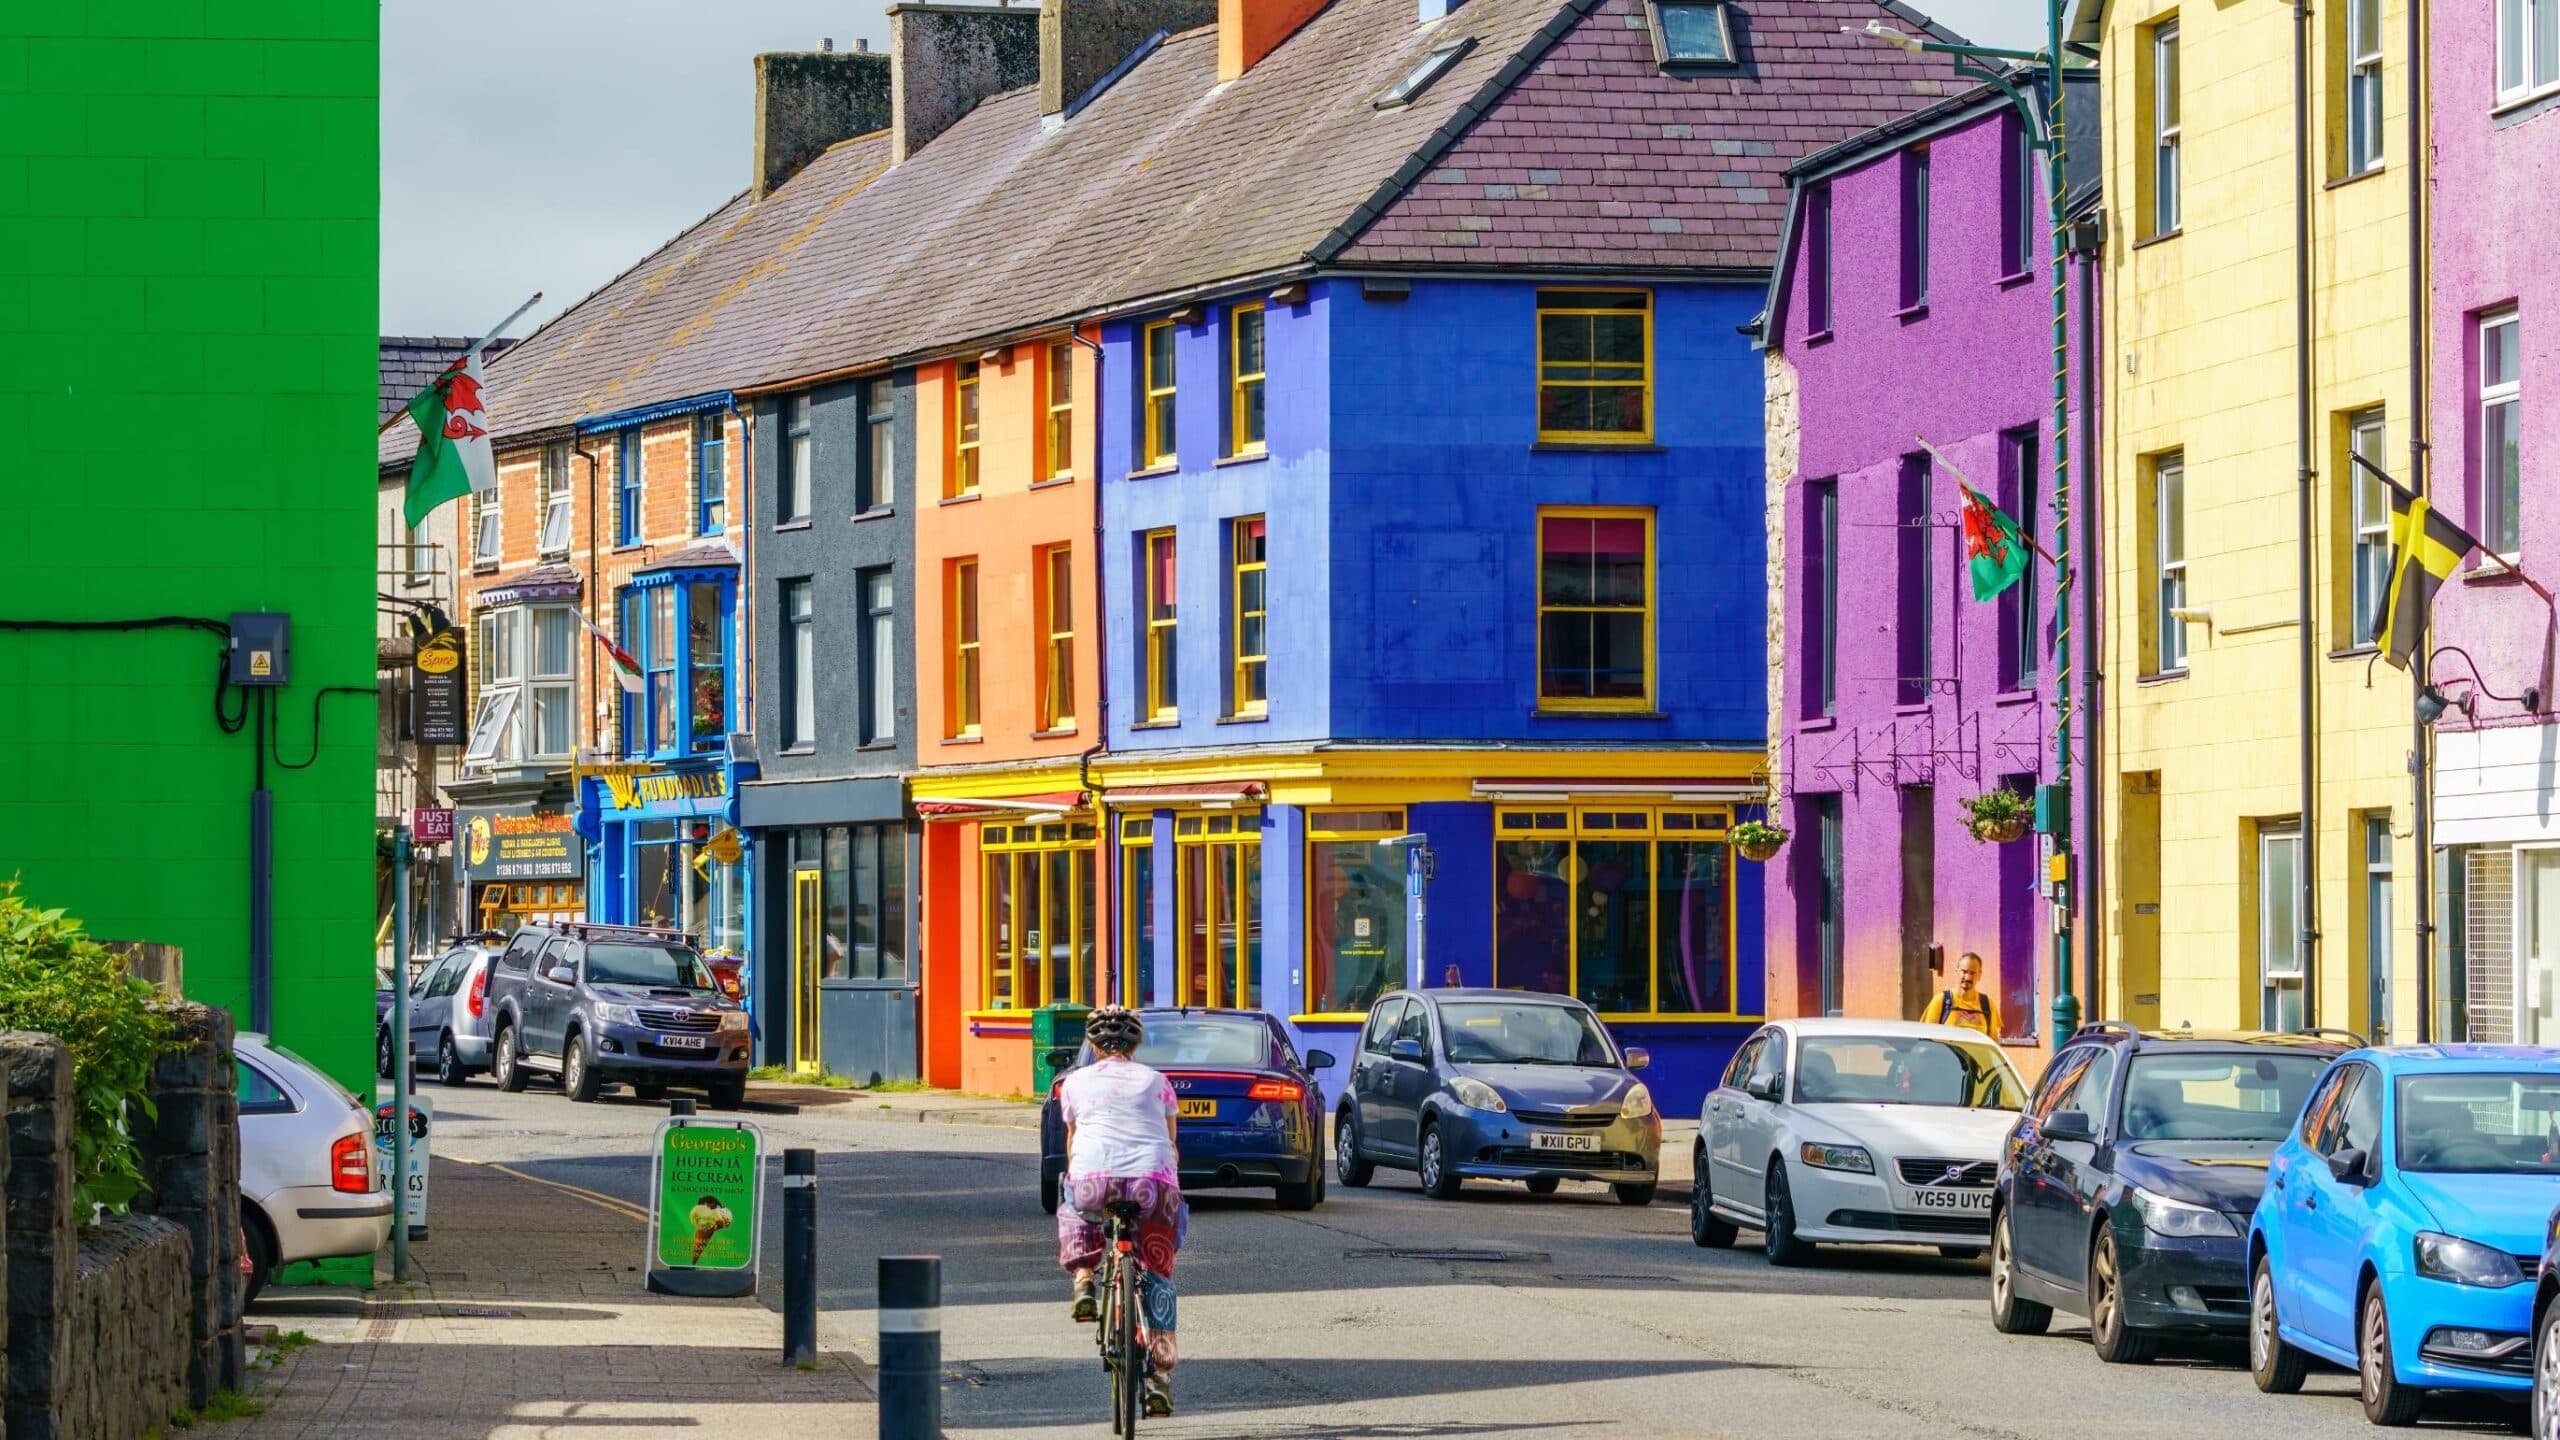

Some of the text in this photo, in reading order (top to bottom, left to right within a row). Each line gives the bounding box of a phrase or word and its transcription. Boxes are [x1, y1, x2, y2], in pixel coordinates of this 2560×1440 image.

[419, 811, 451, 822] JUST
[427, 822, 451, 834] EAT
[663, 1036, 702, 1048] KV14 AHE
[1183, 1101, 1211, 1115] JVM
[671, 1134, 748, 1154] Georgio's
[1541, 1135, 1591, 1149] WX11 GPU
[676, 1156, 723, 1168] HUFEN
[672, 1171, 744, 1184] ICE CREAM
[1915, 1190, 1993, 1209] YG59 UYC
